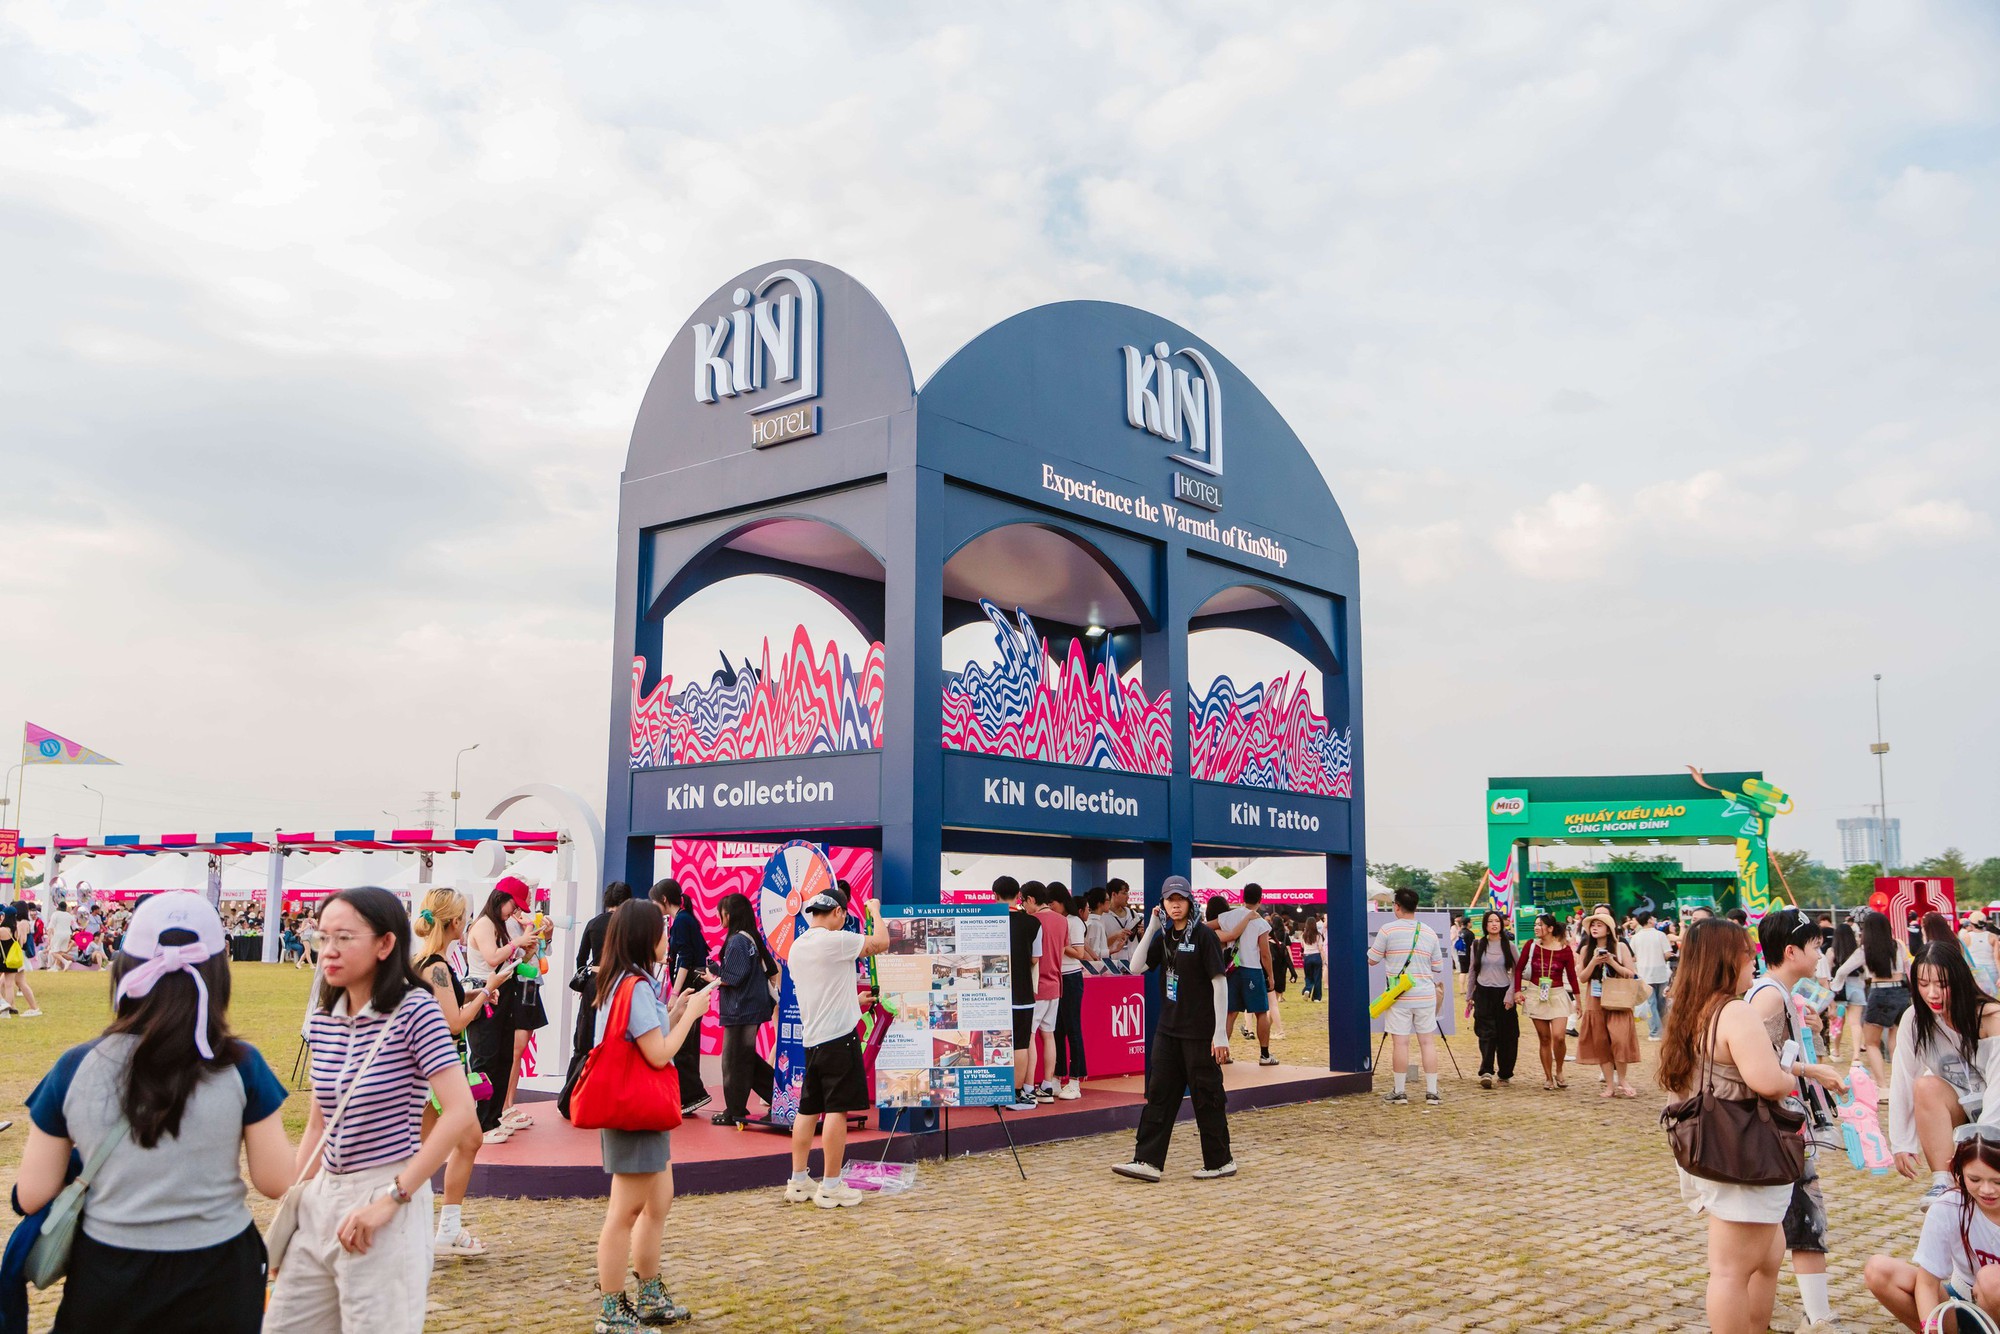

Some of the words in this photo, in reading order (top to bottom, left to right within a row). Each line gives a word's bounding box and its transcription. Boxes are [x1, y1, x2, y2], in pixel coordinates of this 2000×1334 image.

[752, 411, 810, 446] HOTEL
[1180, 474, 1223, 508] HOTEL
[1041, 463, 1133, 516] Experience
[1135, 496, 1159, 524] the
[1161, 503, 1220, 543] Warmth
[1222, 526, 1237, 547] of
[1237, 528, 1288, 568] KinShip
[667, 783, 705, 811] KiN
[713, 776, 835, 808] Collection
[984, 777, 1026, 807] KiN
[1034, 783, 1139, 817] Collection
[1496, 802, 1520, 810] MILO
[1230, 802, 1260, 827] KiN
[1267, 808, 1321, 832] Tattoo
[1565, 808, 1615, 825] KHUẤY
[1653, 804, 1686, 818] NÀO
[1602, 822, 1637, 832] NGON
